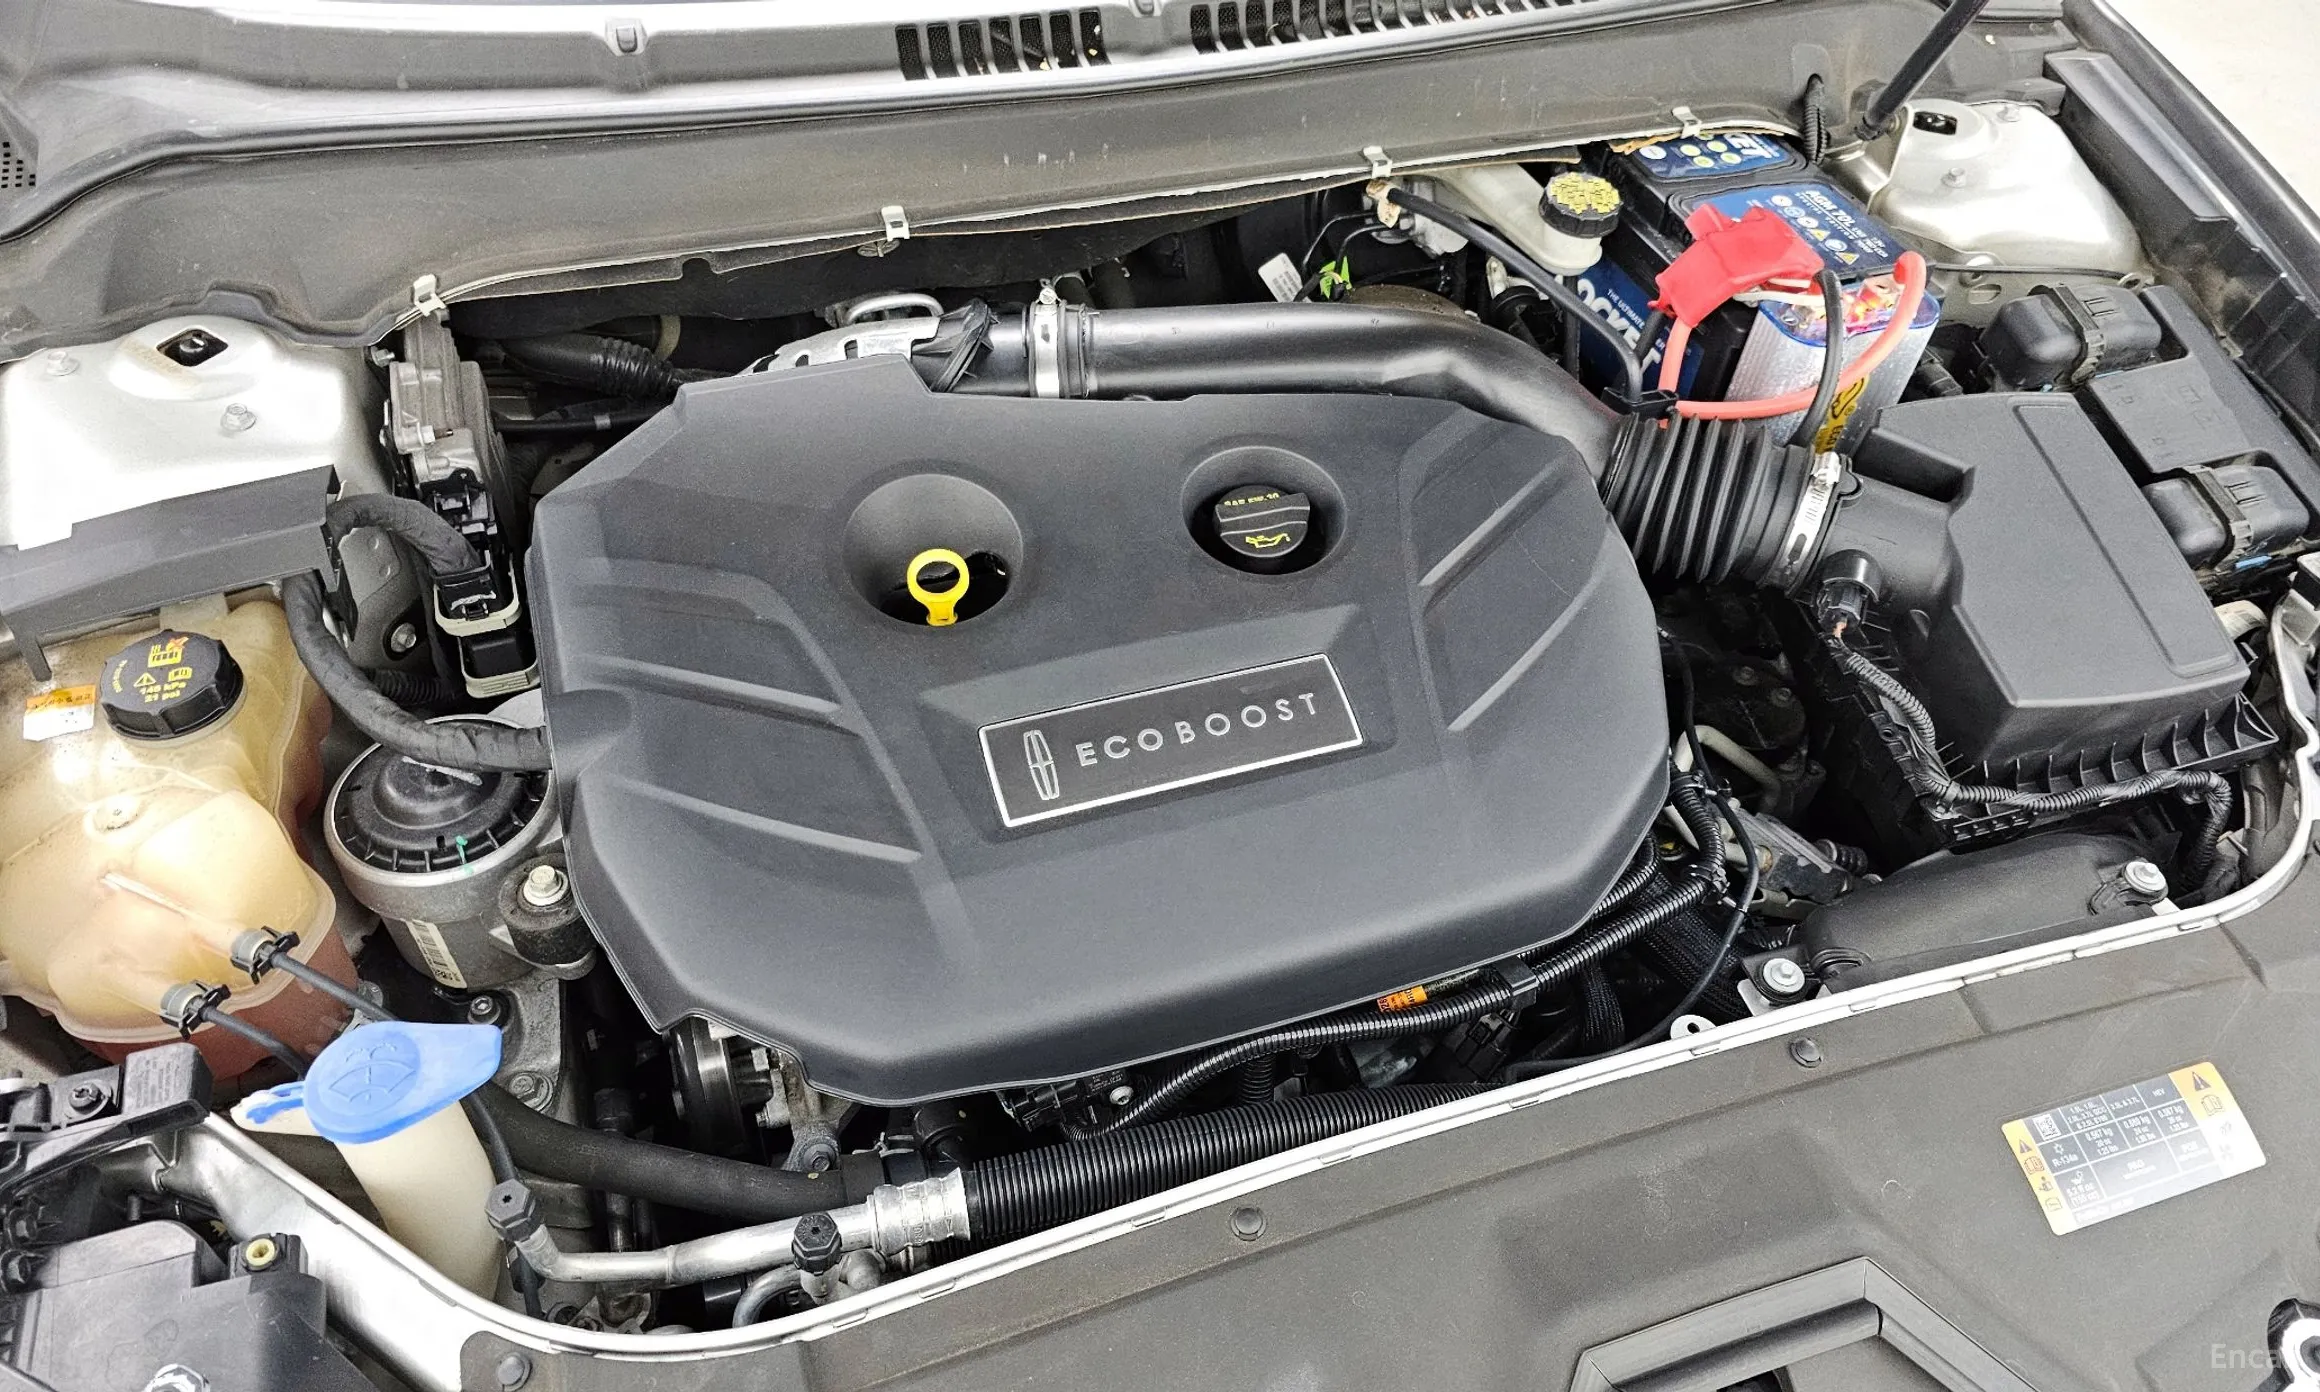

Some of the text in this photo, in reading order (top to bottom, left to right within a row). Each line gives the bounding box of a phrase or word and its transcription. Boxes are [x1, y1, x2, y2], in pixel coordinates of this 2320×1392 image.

[1804, 190, 1838, 211] AGM
[1831, 209, 1856, 228] 70L
[1607, 288, 1646, 330] THE ULTIMATE
[1075, 692, 1317, 767] ECOBOOST
[2052, 1154, 2079, 1168] R-134a
